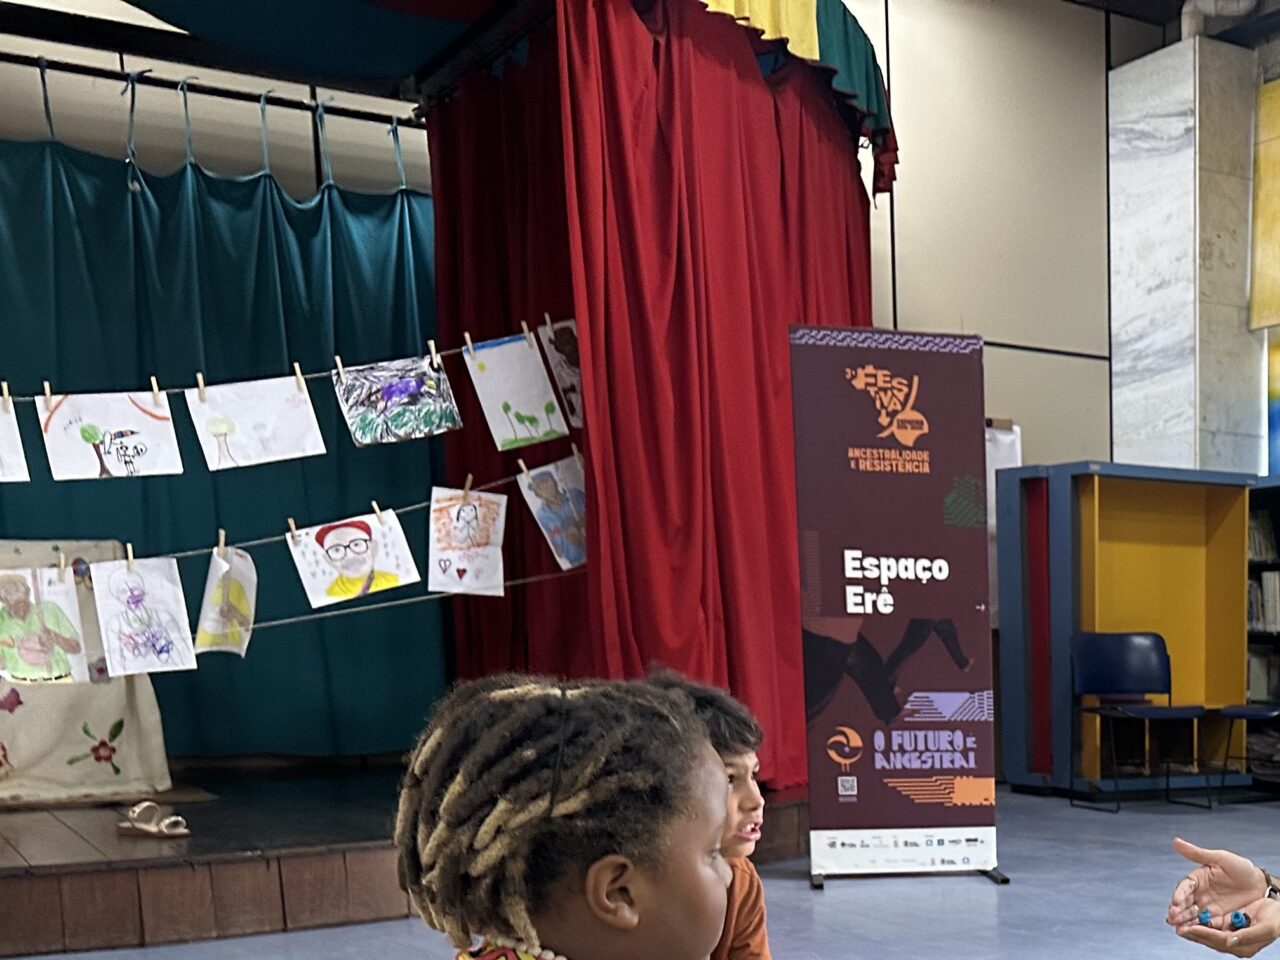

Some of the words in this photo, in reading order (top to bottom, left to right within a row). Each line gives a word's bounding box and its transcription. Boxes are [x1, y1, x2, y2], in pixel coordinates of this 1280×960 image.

[848, 447, 930, 461] ANCESTRALIDADE
[859, 459, 931, 474] RESISTÊNCIA
[844, 549, 950, 585] Espaço
[845, 585, 895, 614] Erê
[874, 730, 885, 751] O
[891, 730, 964, 751] FUTURO
[874, 752, 977, 769] ANCESTRAL
